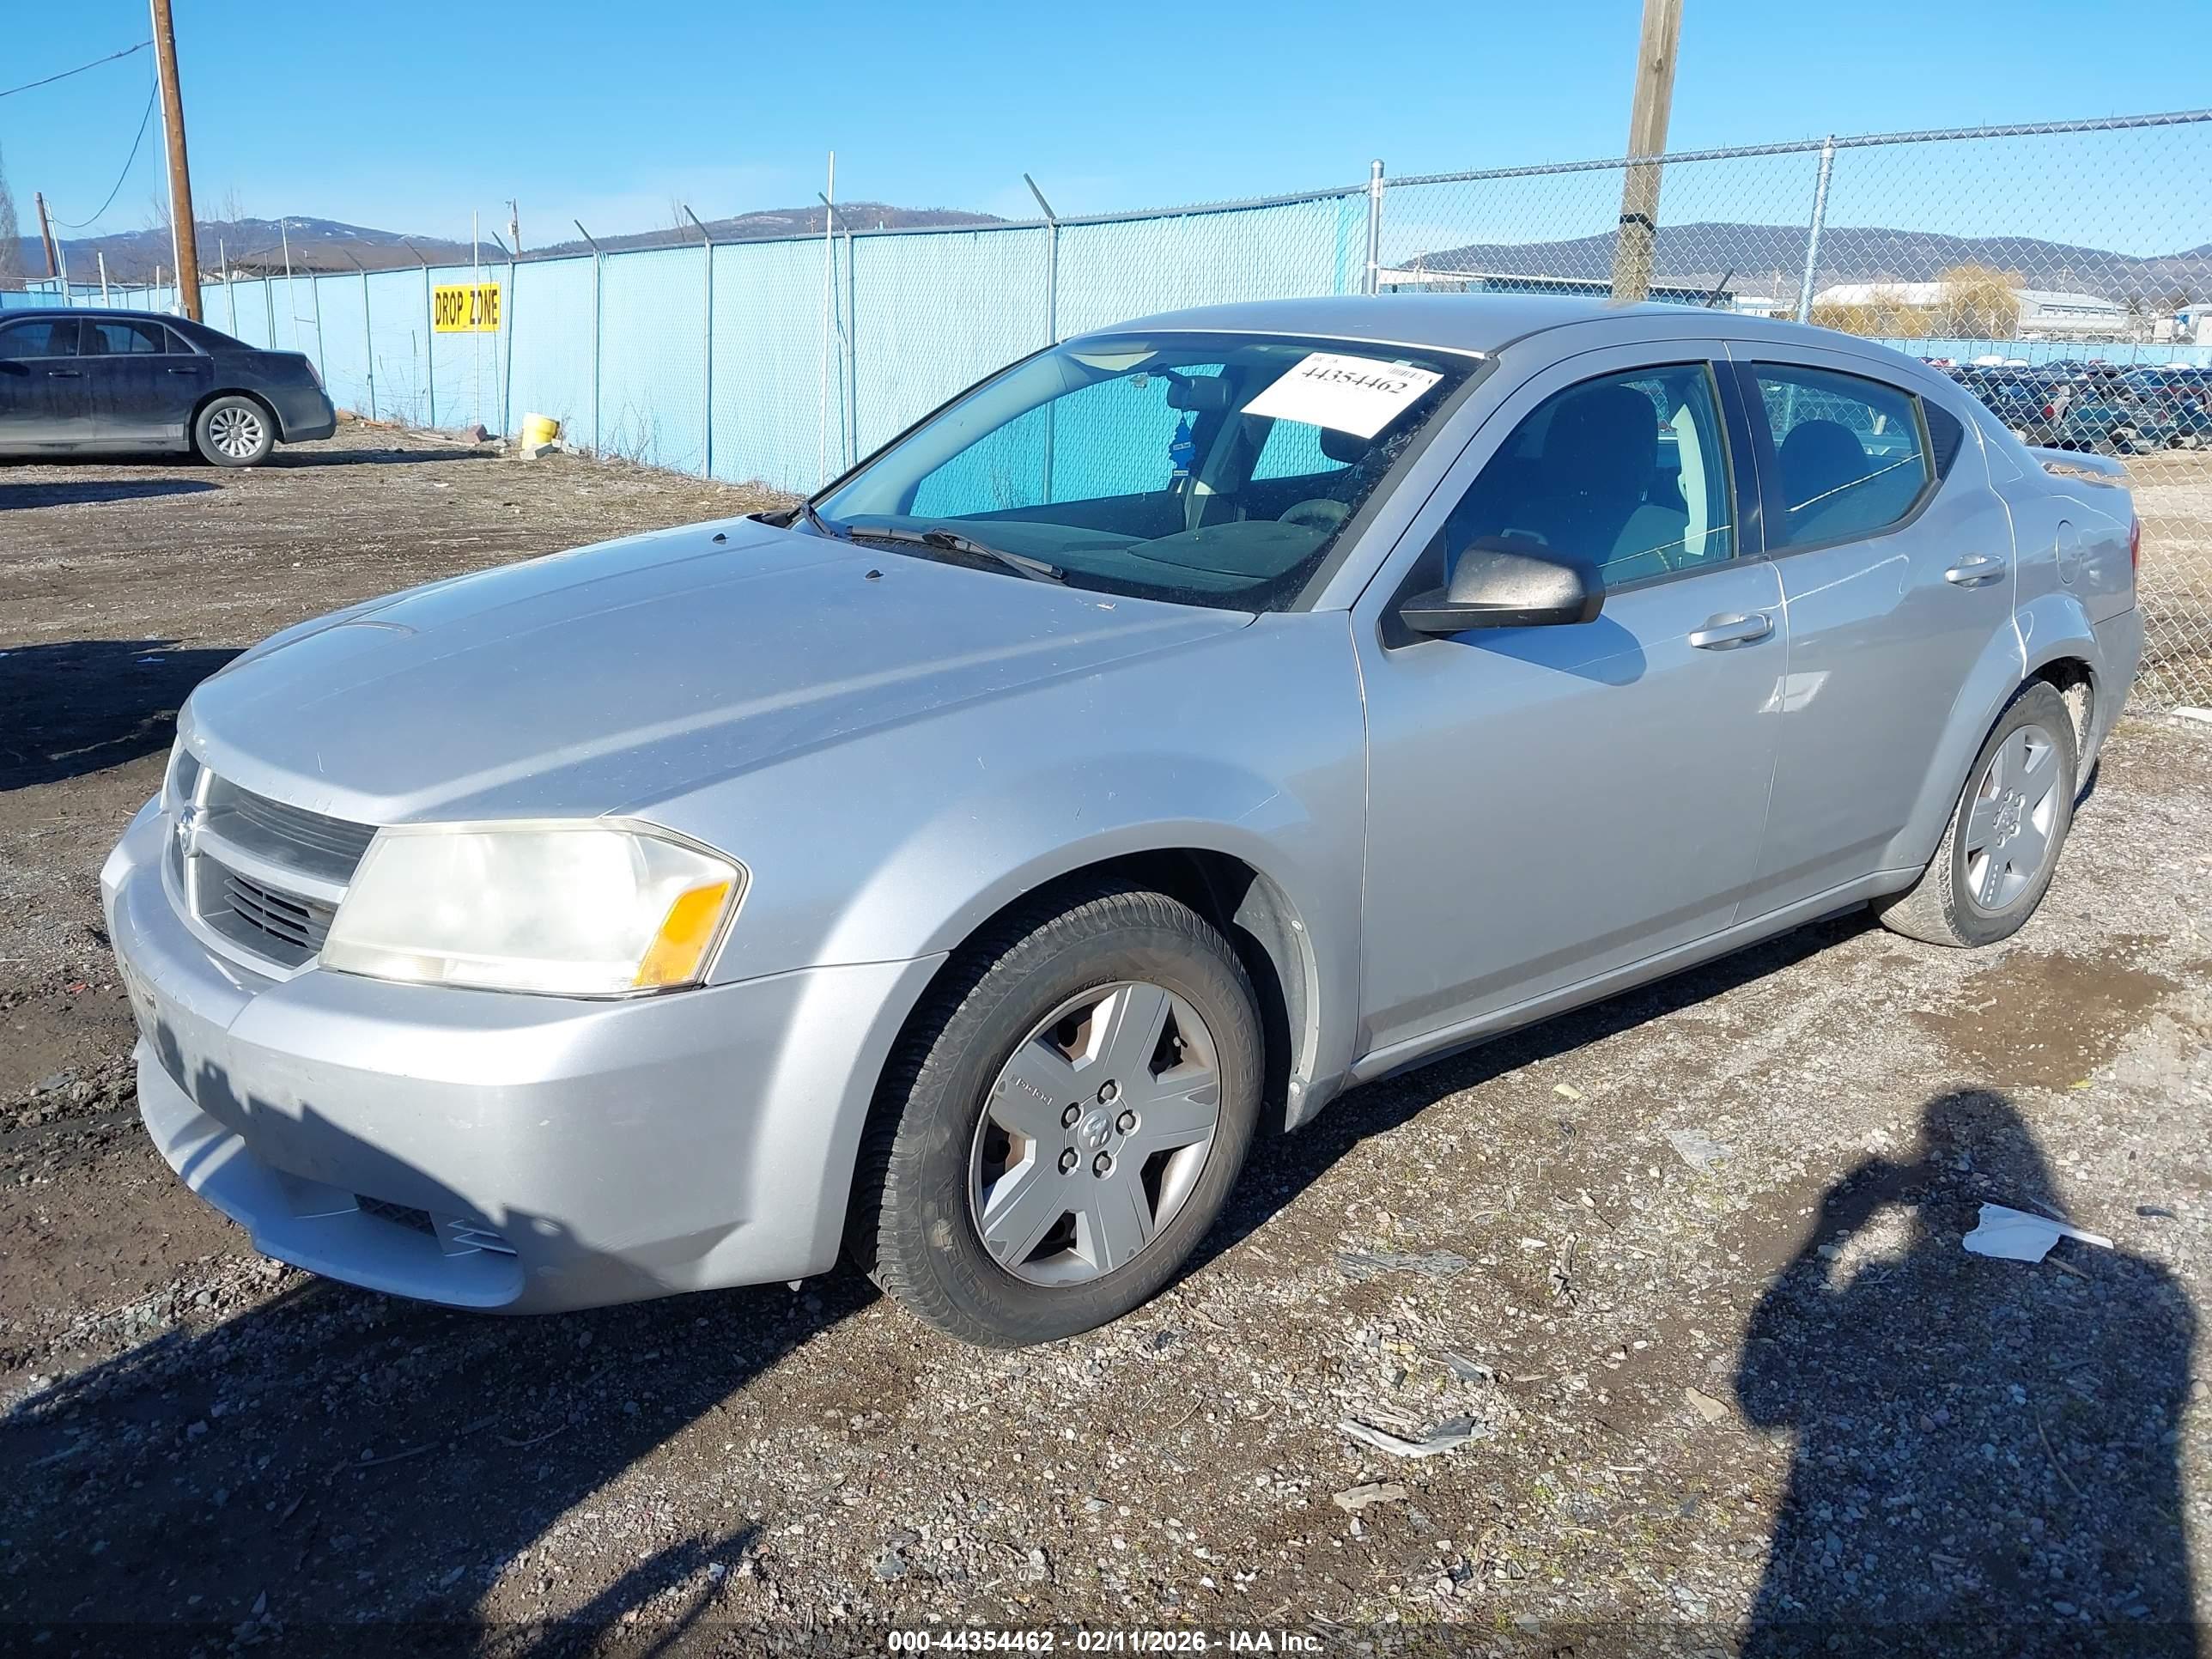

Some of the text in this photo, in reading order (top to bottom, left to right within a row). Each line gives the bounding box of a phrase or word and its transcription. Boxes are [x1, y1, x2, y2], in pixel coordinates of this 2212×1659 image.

[435, 289, 497, 325] DROP ZONE
[1302, 367, 1408, 394] 44354462
